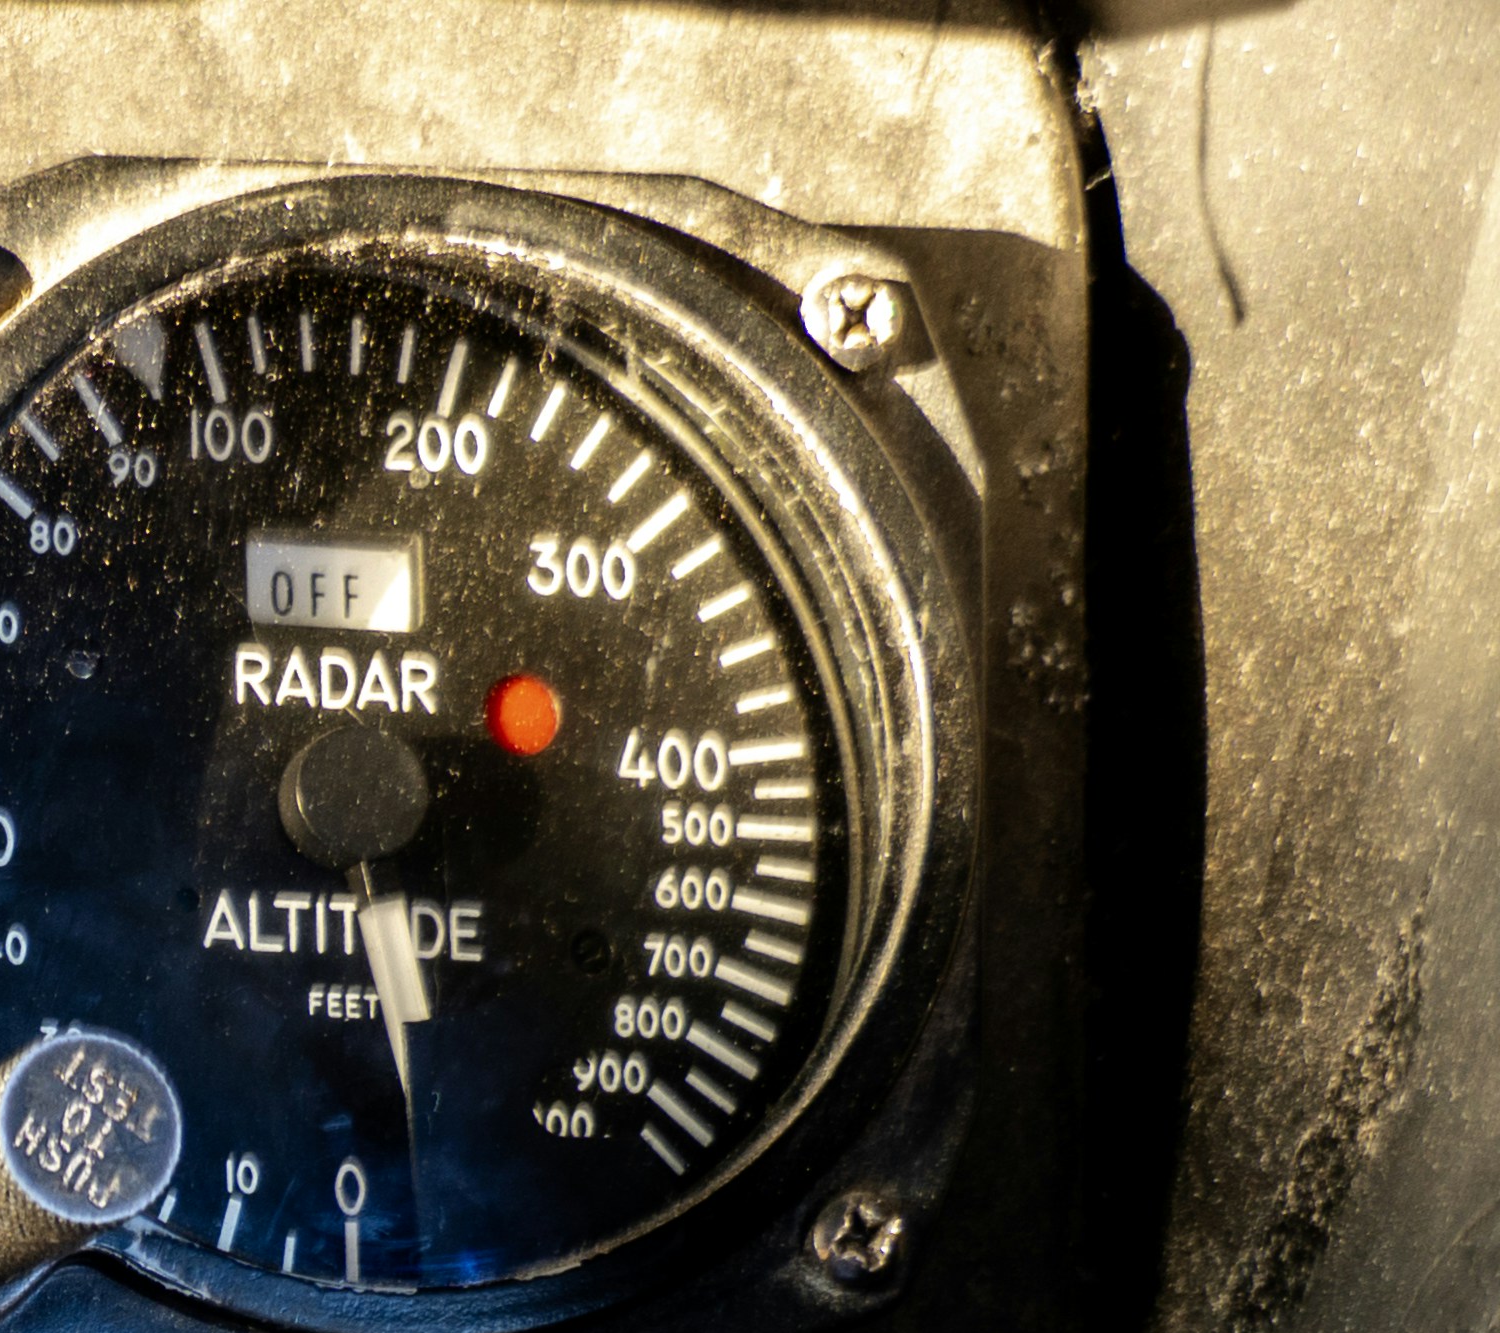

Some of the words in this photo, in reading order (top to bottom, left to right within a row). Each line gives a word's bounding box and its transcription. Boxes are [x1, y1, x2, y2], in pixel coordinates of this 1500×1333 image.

[190, 408, 272, 464] 100
[385, 412, 488, 475] 200
[108, 455, 157, 487] 90
[29, 518, 77, 556] 80
[527, 536, 636, 600] 300
[270, 570, 360, 617] OFF
[235, 648, 437, 714] RADAR
[618, 730, 729, 791] 400
[661, 804, 734, 847] 500
[655, 872, 729, 911] 600
[203, 896, 483, 962] ALTITDE
[643, 937, 713, 978] 700
[308, 990, 381, 1019] FEET
[614, 1003, 684, 1040] 800
[225, 1156, 258, 1195] 10
[335, 1160, 367, 1216] 0
